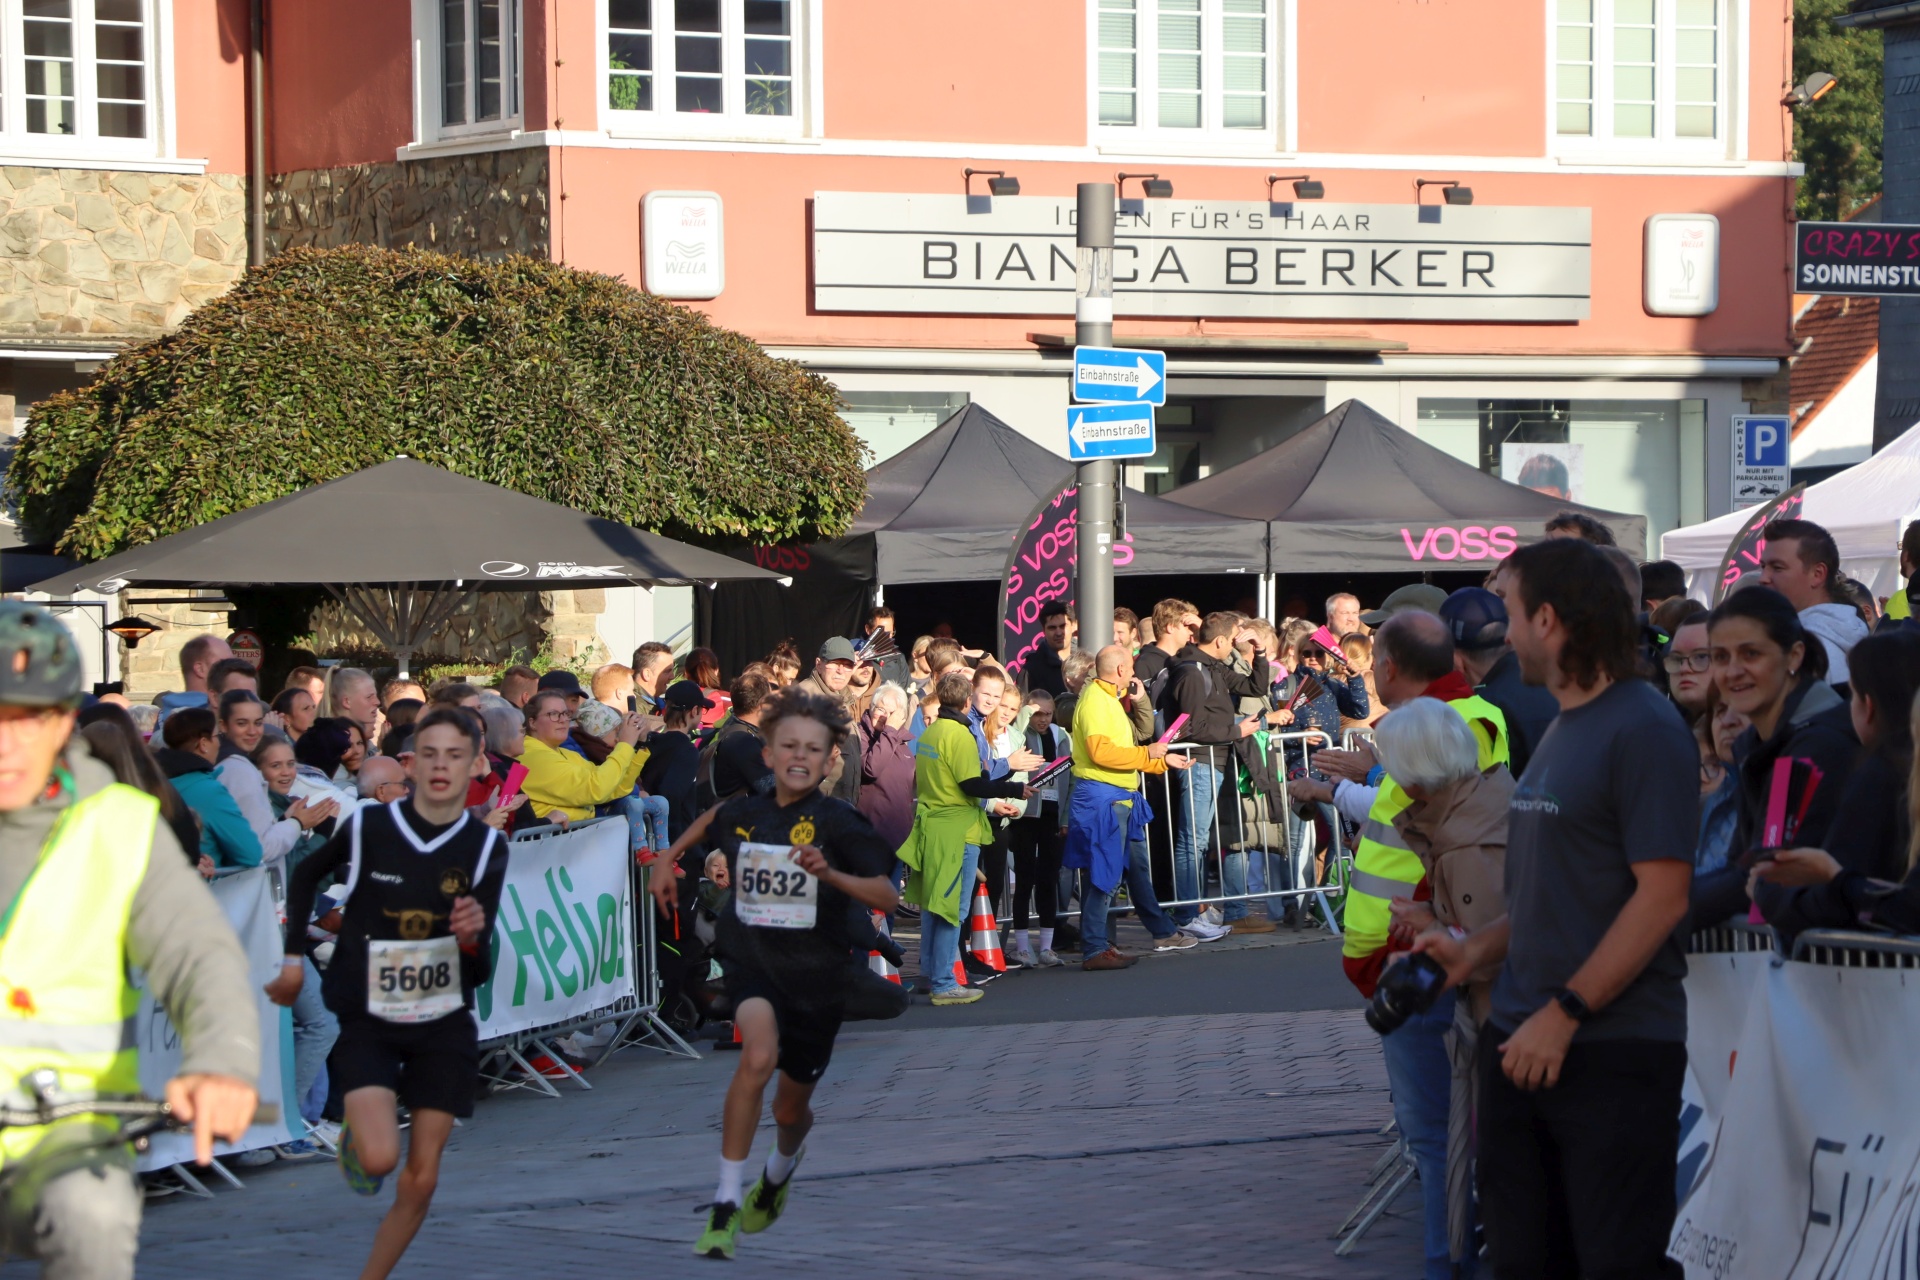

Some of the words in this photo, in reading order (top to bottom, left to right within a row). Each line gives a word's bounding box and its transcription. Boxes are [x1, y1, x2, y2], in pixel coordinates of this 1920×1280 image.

[681, 218, 706, 227] WELLA
[1284, 209, 1370, 232] HAAR
[1803, 229, 1901, 258] CRAZY
[665, 260, 706, 275] WELLA
[1225, 246, 1496, 288] BERKER
[1080, 368, 1139, 383] Einbahnstraße
[1082, 423, 1147, 439] Einbahnstraße
[1755, 425, 1778, 461] P
[1399, 525, 1518, 561] VOSS
[536, 565, 627, 578] MAX
[1004, 567, 1069, 636] VOSS
[232, 650, 260, 658] PETERS
[794, 824, 812, 839] BVB
[742, 868, 807, 897] 5632
[379, 962, 451, 992] 5608
